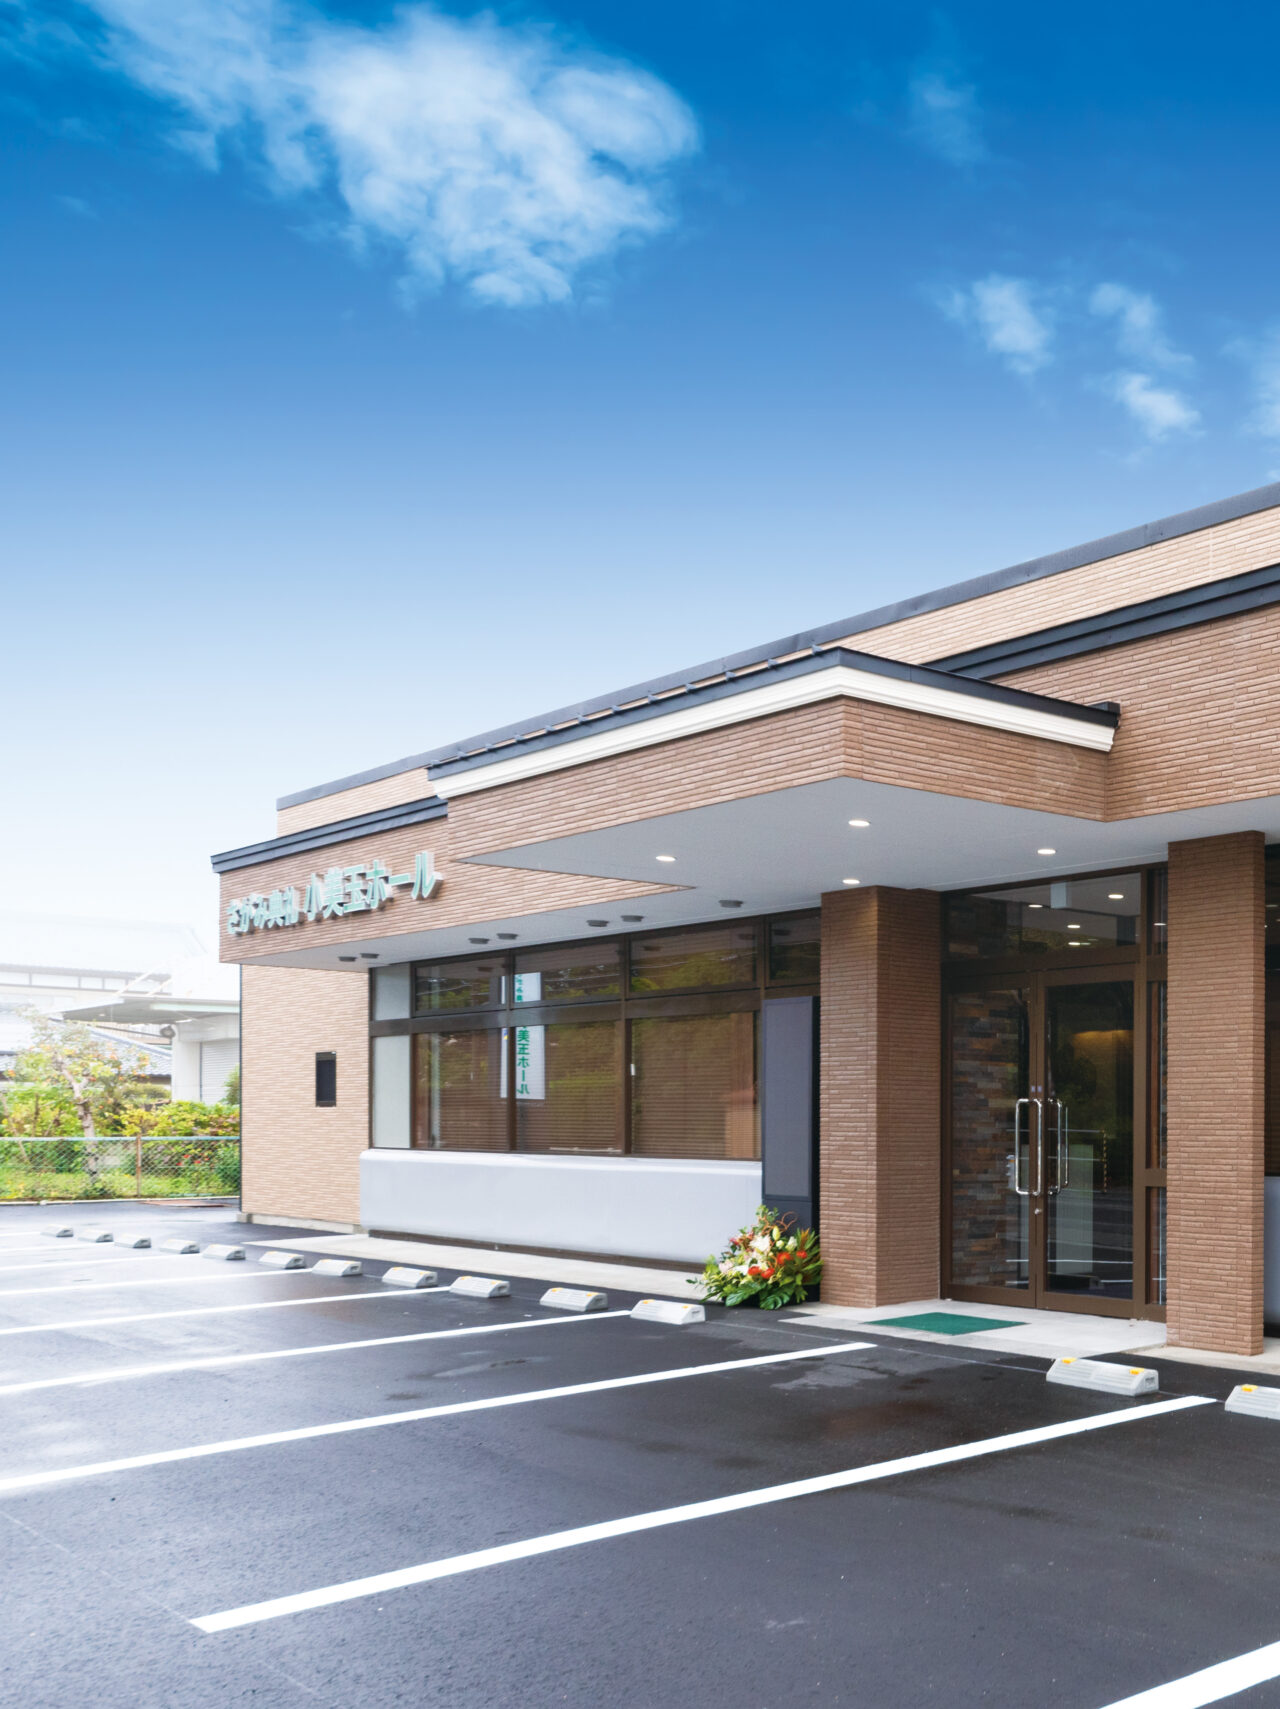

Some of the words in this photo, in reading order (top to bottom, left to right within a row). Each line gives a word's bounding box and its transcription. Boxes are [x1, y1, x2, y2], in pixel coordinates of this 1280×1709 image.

[226, 886, 299, 935] さがみ典礼
[304, 851, 441, 921] 小美玉ホール
